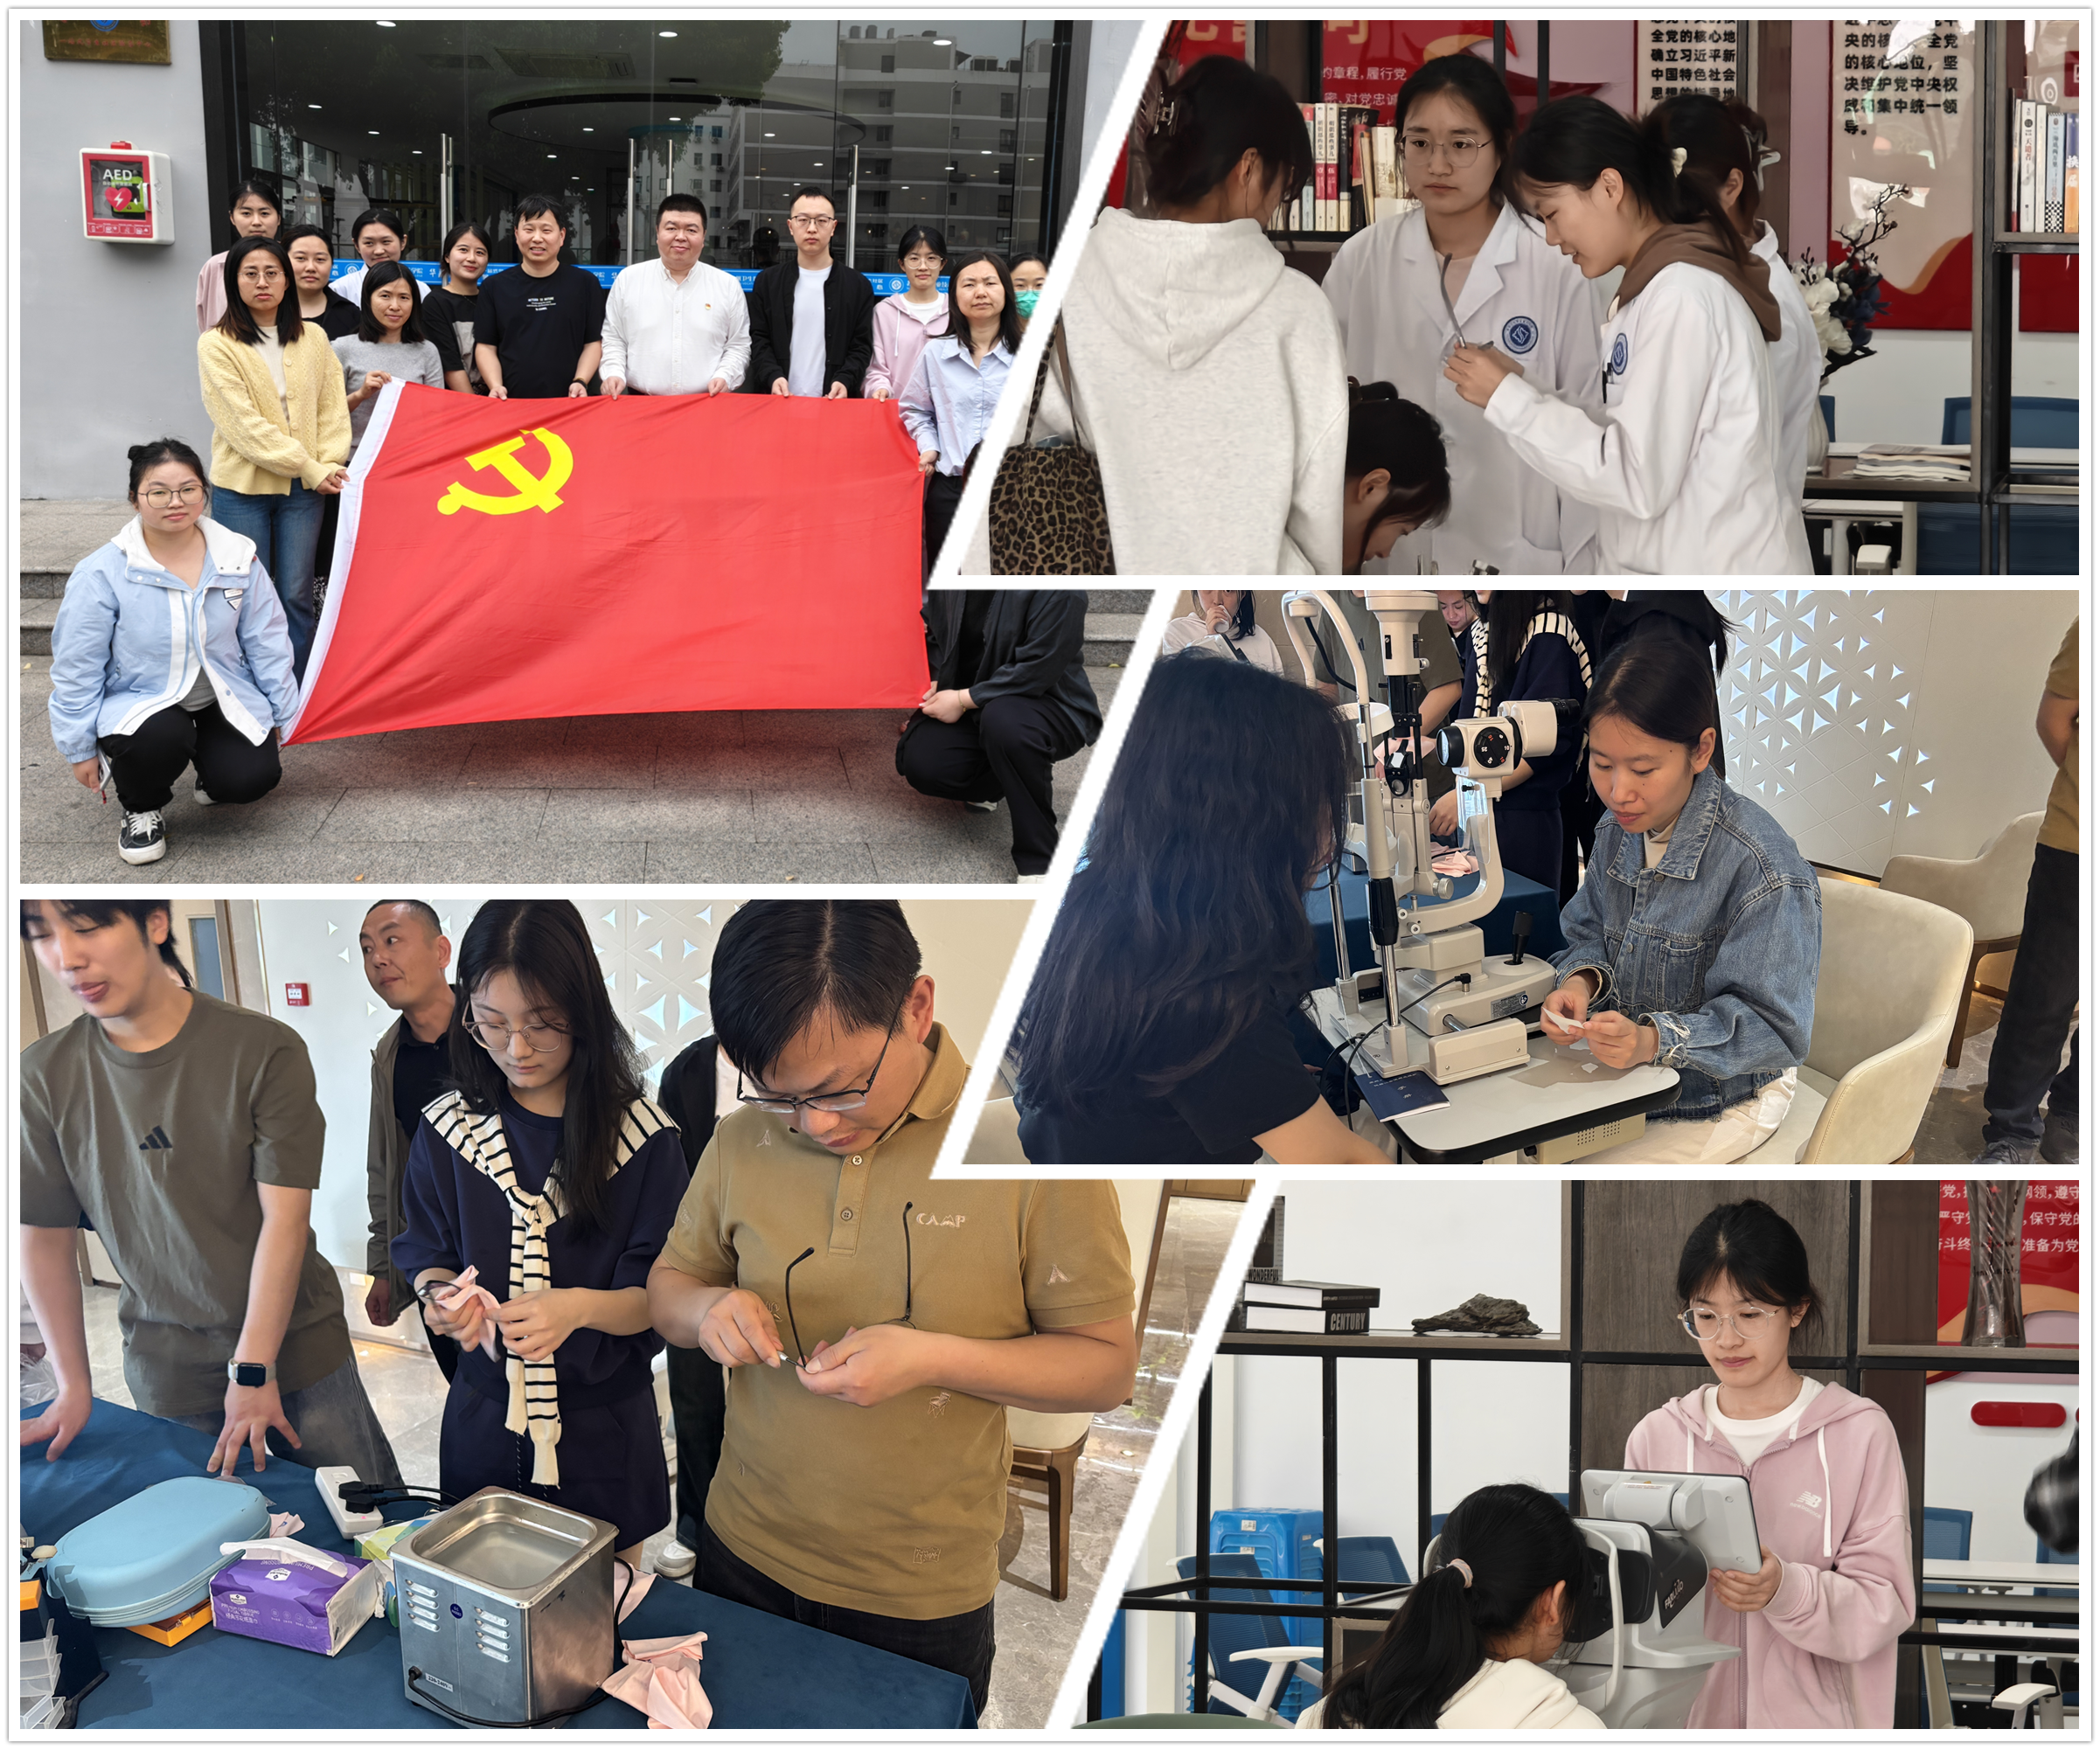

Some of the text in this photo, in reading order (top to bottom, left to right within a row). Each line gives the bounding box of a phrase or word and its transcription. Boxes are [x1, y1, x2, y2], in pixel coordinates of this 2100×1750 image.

[1651, 29, 1736, 43] 全党的核心地
[1651, 48, 1736, 62] 确立习近平新
[1651, 67, 1736, 81] 中国特色社会
[1844, 76, 1958, 92] 决维护党中央权
[1844, 98, 1958, 114] 威和集中统一领
[1844, 119, 1867, 135] 导。
[102, 169, 133, 181] AED
[1940, 1184, 1967, 1198] 党，
[915, 1212, 965, 1228] CAMP
[1938, 1237, 1971, 1251] 斗终
[2021, 1238, 2079, 1253] 准备为党
[1248, 1268, 1279, 1281] WONDERFUL
[1330, 1312, 1366, 1331] CENTURY
